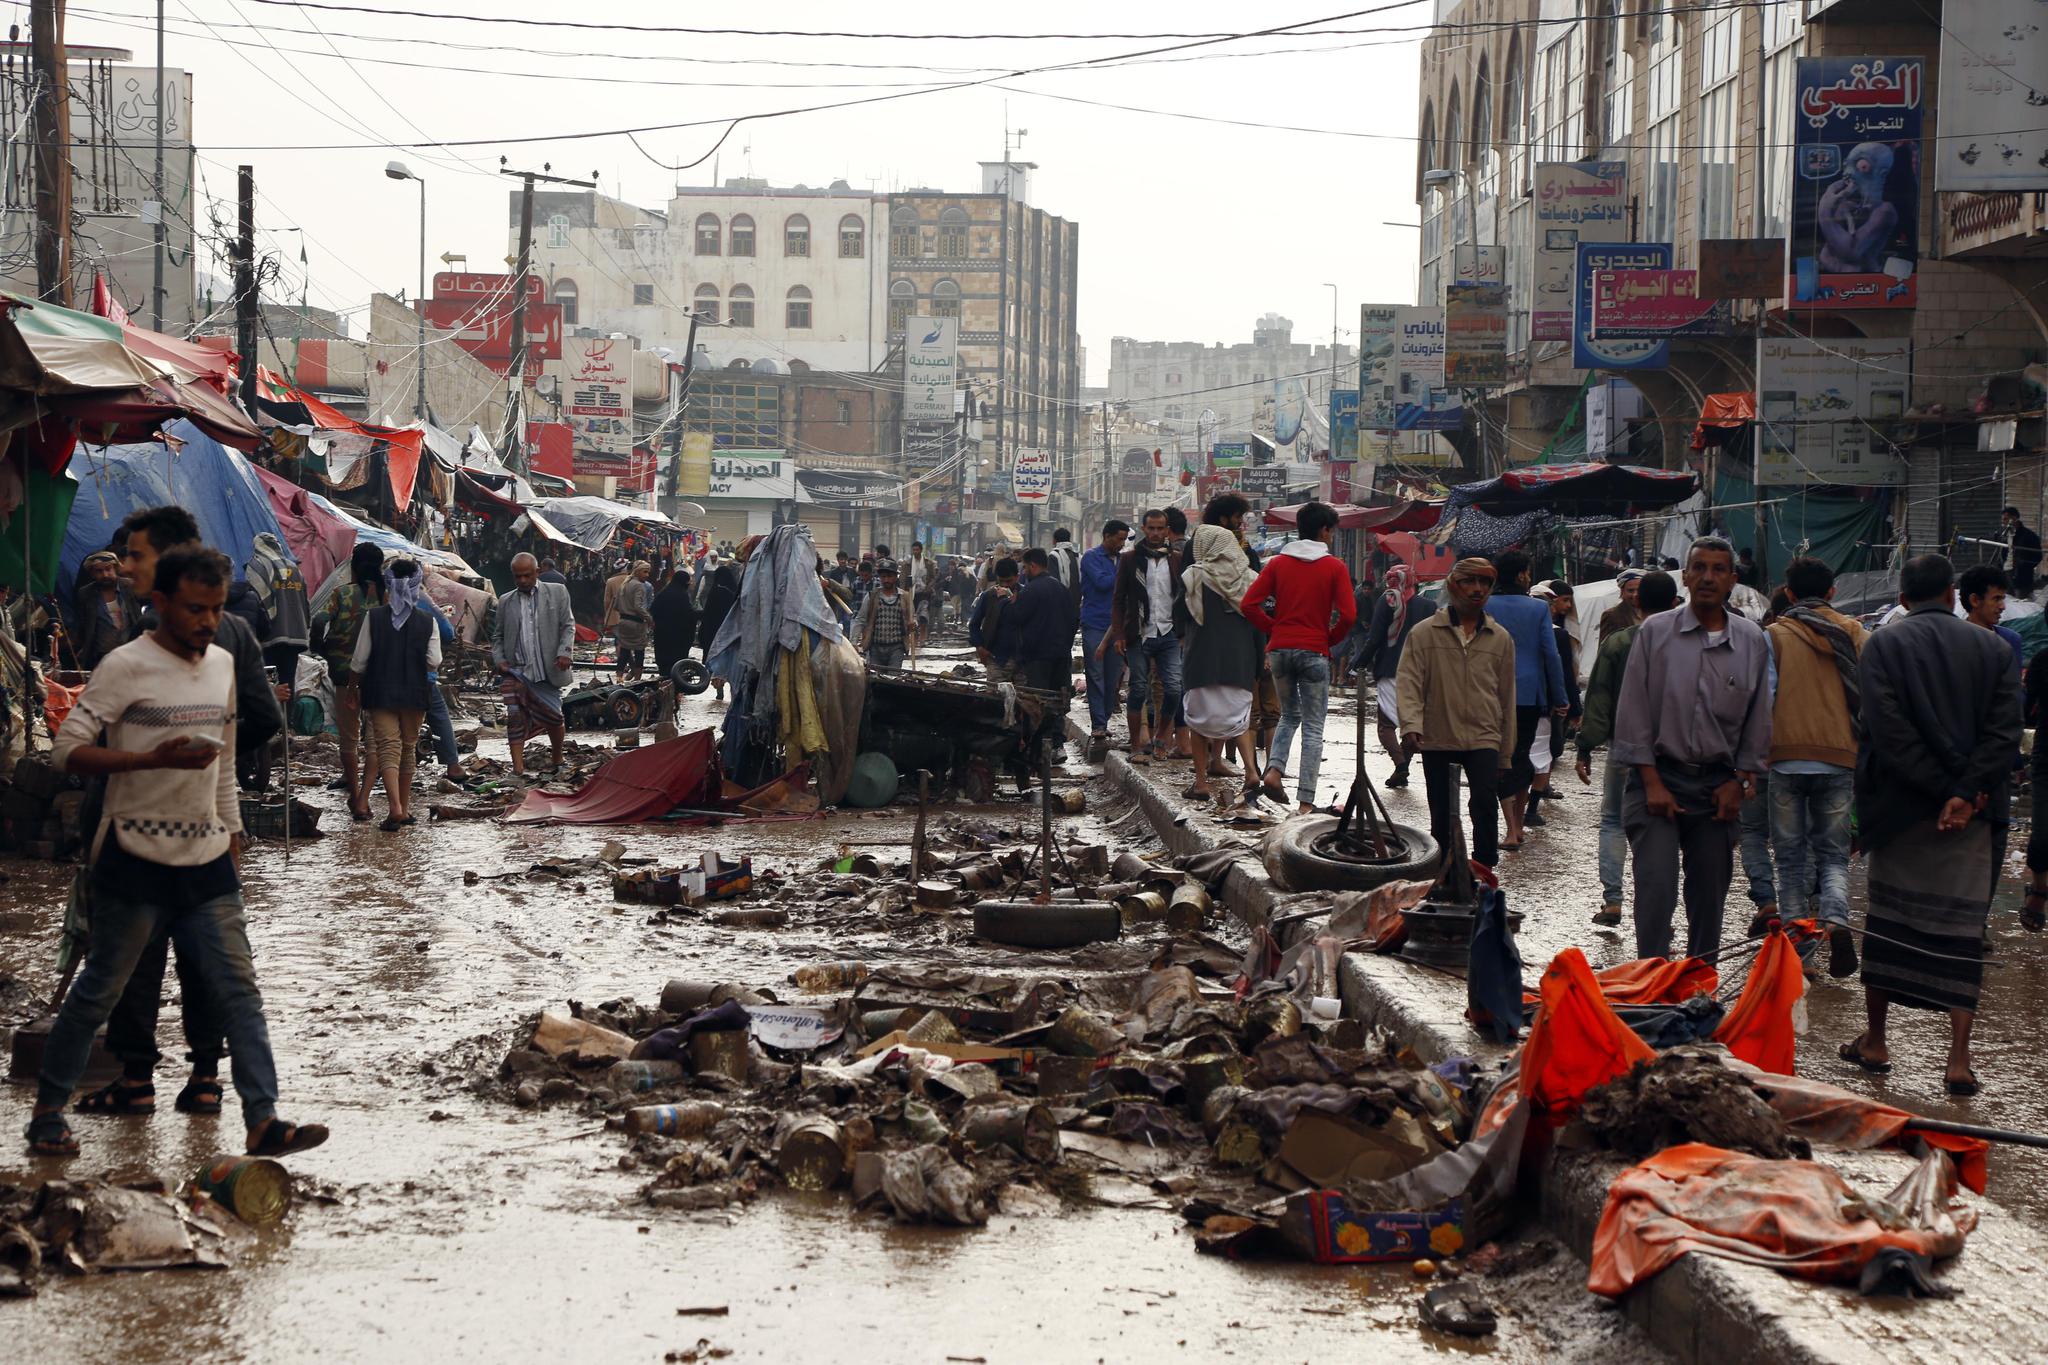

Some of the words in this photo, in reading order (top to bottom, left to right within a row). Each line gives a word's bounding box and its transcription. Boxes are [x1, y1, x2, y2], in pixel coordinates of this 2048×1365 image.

[1854, 115, 1904, 133] للتجارة
[1539, 176, 1623, 203] الحيدري
[437, 275, 540, 297] تفيضات
[1839, 282, 1879, 300] العقبي
[909, 353, 953, 369] الصيدلية
[926, 387, 935, 401] 2
[913, 402, 946, 410] GERMAN
[908, 412, 950, 420] PHARMACY
[1018, 449, 1048, 465] الأصيل
[1015, 465, 1050, 477] للخياطة
[1015, 476, 1050, 488] الرجالية
